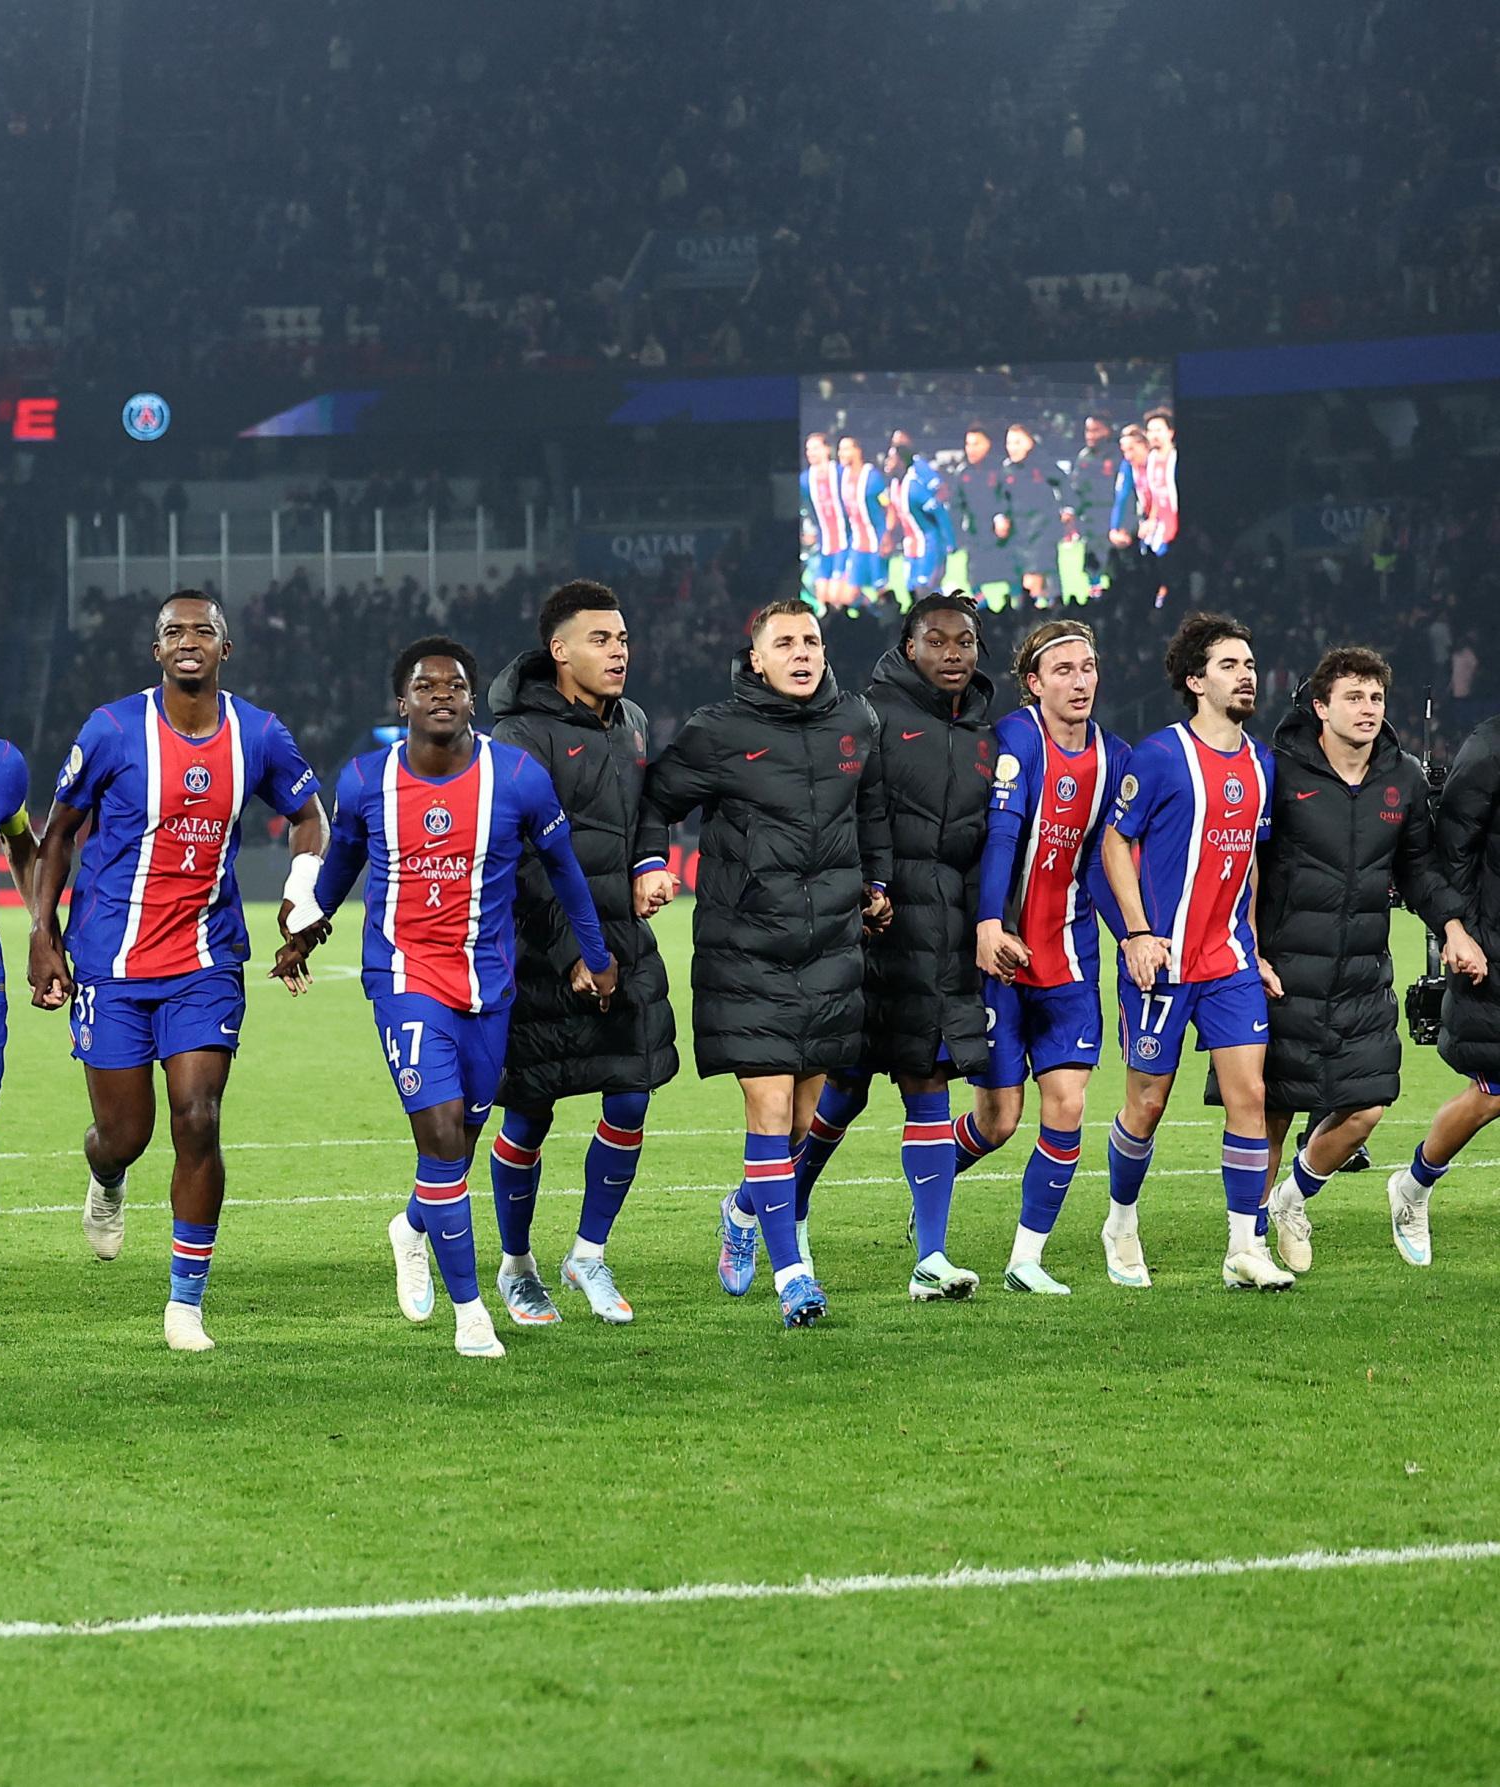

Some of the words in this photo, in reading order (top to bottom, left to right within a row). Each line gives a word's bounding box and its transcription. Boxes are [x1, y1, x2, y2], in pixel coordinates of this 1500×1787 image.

[611, 534, 697, 560] QATAR
[164, 816, 222, 834] QATAR
[1039, 819, 1081, 841] QATAR
[177, 831, 221, 843] AIRWAYS
[1206, 828, 1252, 845] QATAR
[1218, 841, 1252, 853] AIRWAYS
[406, 856, 468, 873] QATAR
[419, 869, 467, 880] AIRWAYS
[1141, 992, 1174, 1034] 17
[386, 1021, 424, 1069] 47
